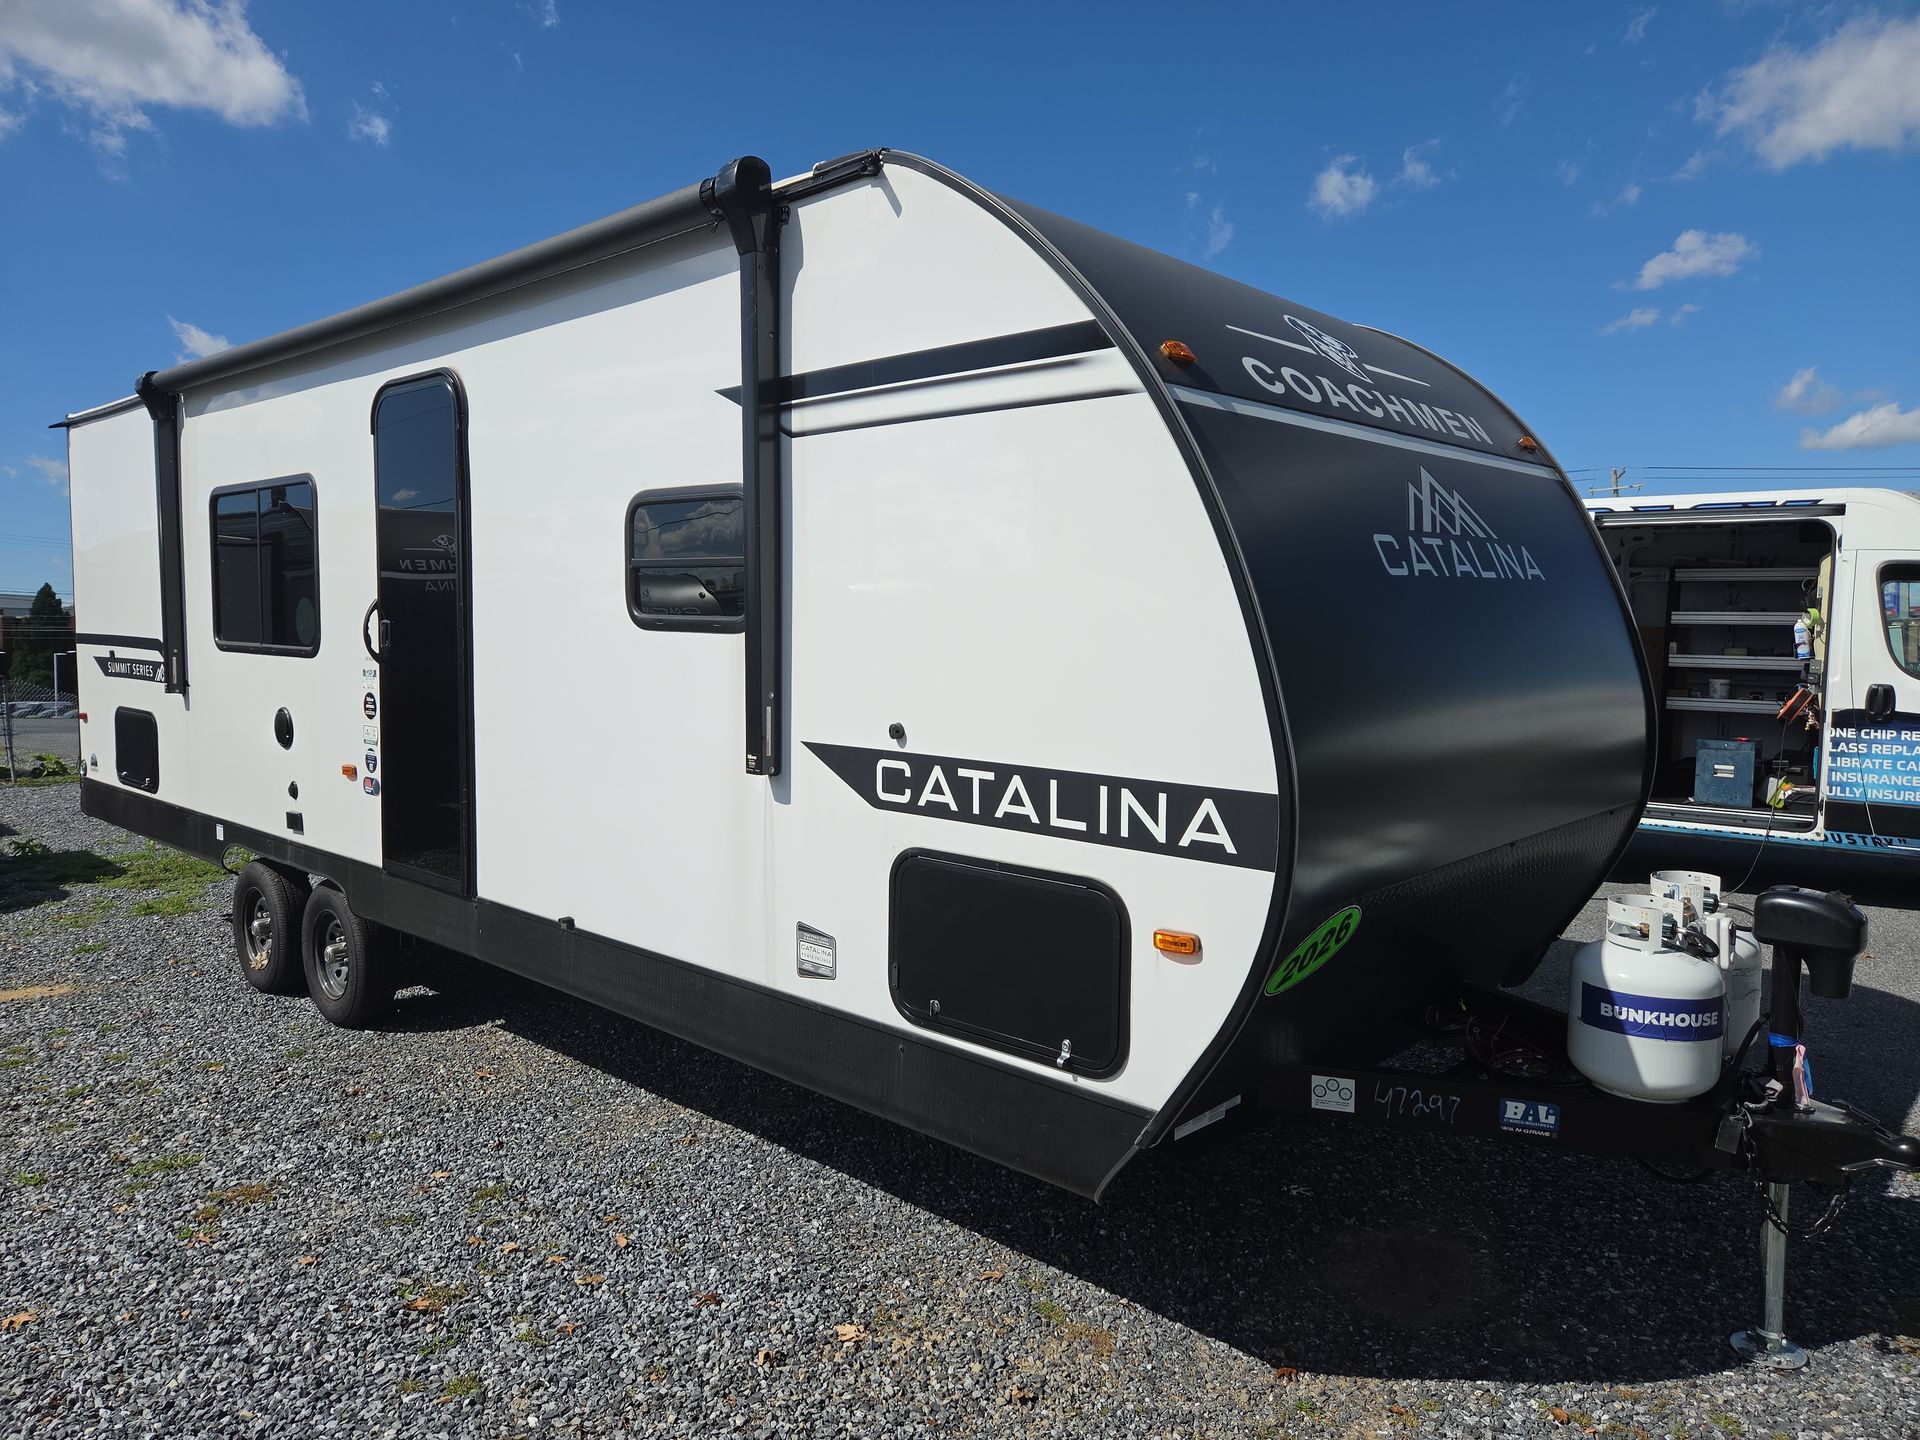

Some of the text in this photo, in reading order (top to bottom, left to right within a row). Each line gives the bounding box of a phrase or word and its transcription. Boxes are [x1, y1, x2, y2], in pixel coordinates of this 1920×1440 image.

[1241, 357, 1494, 445] COACHMEN
[1373, 533, 1546, 581] CATALINA
[108, 661, 154, 677] SUMMIT SERIES
[1860, 729, 1897, 740] CHIP
[1829, 742, 1920, 756] LASS REPLA
[1828, 756, 1920, 772] LIBRATE CA
[1831, 771, 1920, 787] INSURANCE
[1826, 785, 1920, 802] ULLY INSURE
[875, 758, 1238, 855] CATALINA
[800, 944, 831, 957] CATALINA
[1273, 912, 1354, 992] 2026
[1600, 1002, 1718, 1027] BUNKHOUSE
[1373, 1079, 1461, 1124] 47297
